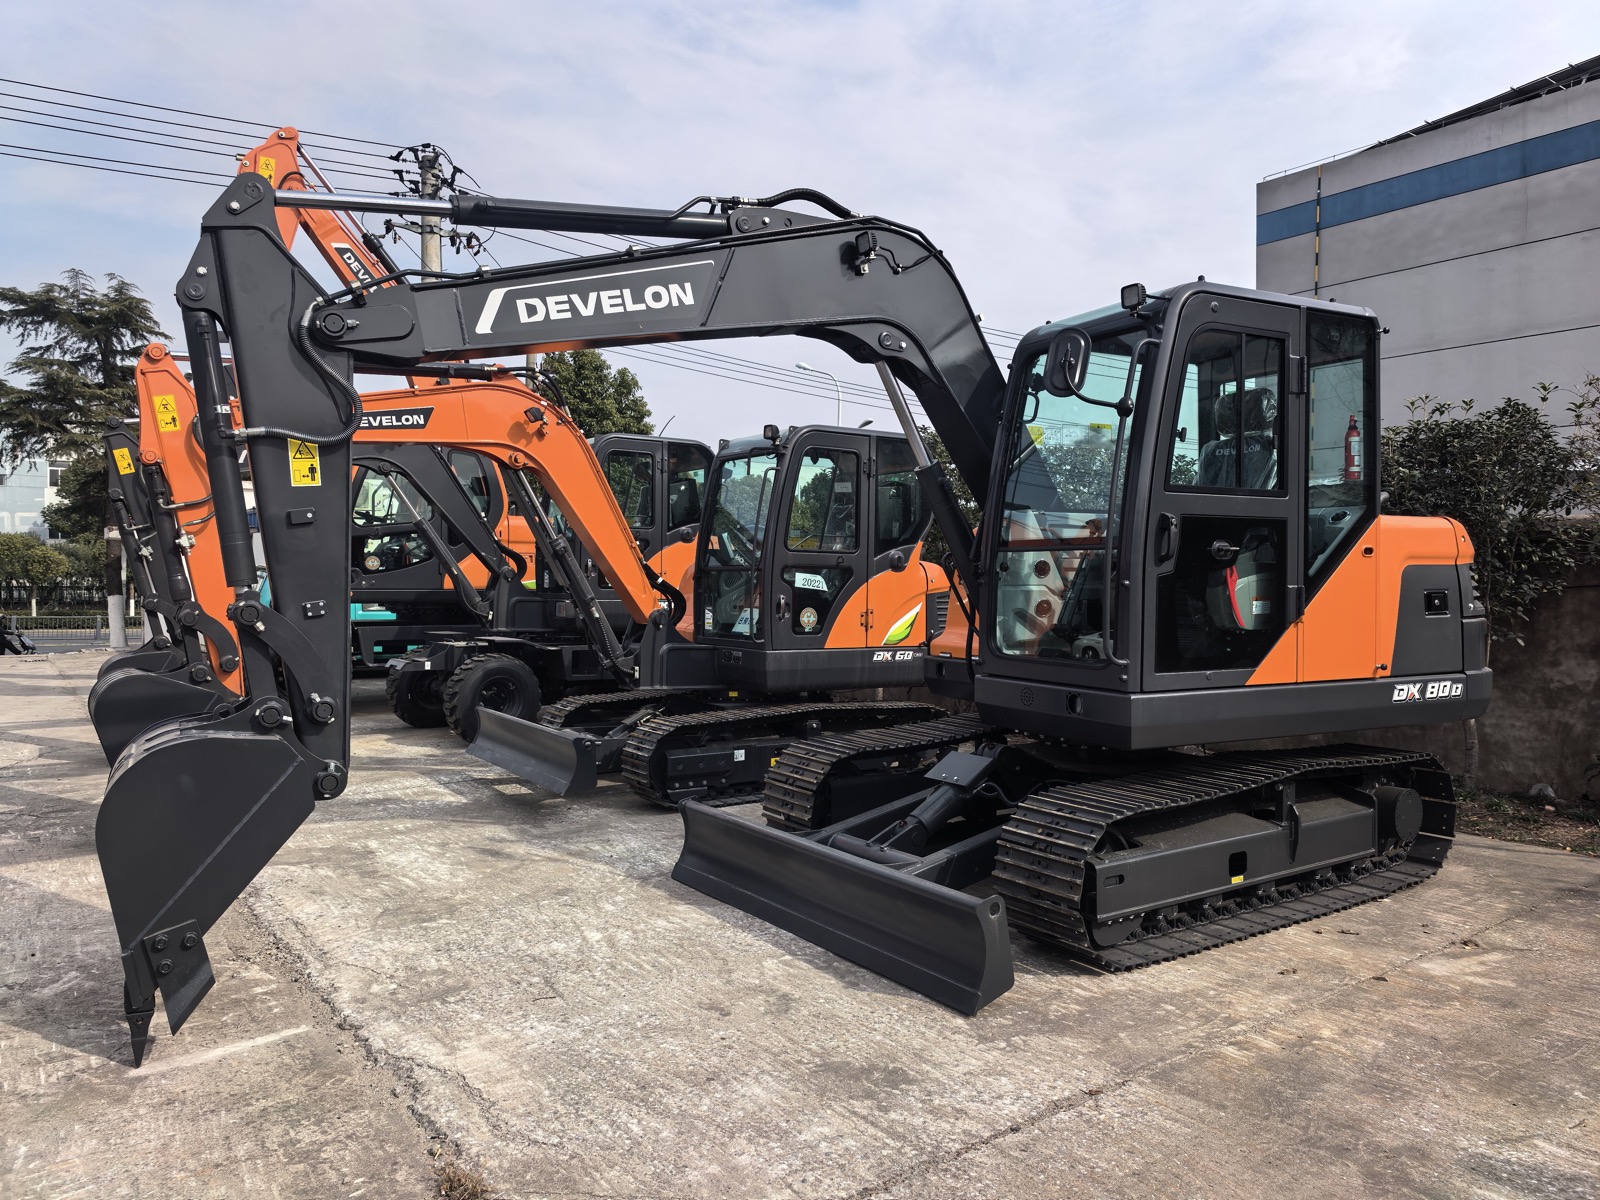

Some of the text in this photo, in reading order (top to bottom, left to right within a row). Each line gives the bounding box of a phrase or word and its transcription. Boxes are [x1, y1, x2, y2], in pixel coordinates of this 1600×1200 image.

[516, 282, 695, 324] DEVELON
[1215, 445, 1261, 456] DEVLON
[873, 651, 894, 662] DX
[1392, 683, 1423, 703] DX
